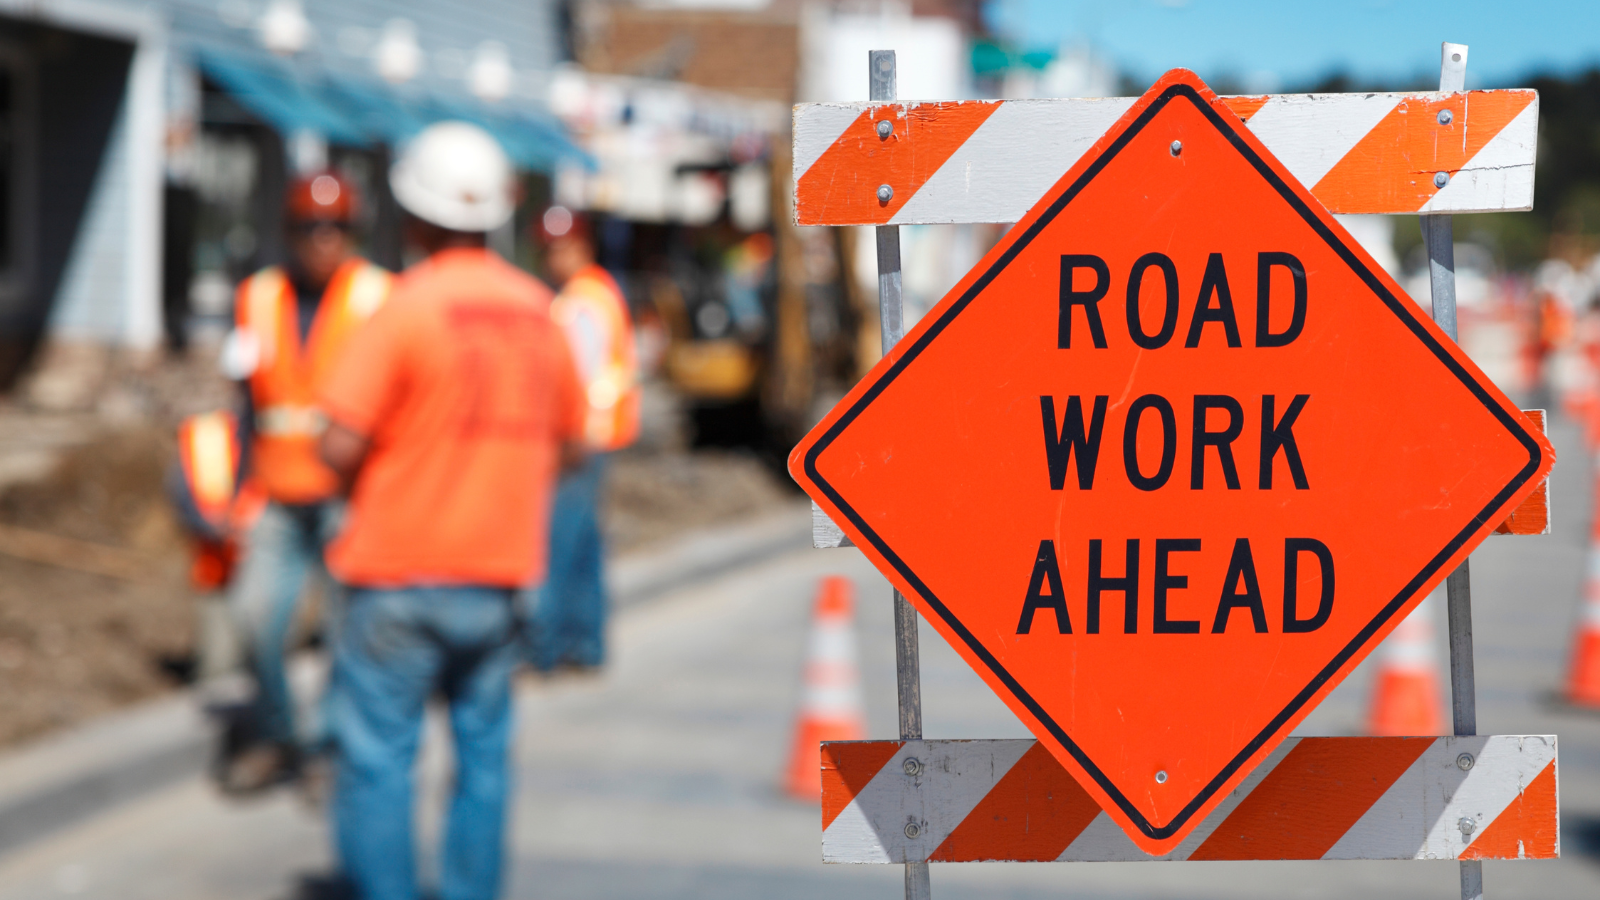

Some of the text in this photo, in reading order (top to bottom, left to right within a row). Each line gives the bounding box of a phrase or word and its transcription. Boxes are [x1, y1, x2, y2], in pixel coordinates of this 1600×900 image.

[1057, 251, 1308, 350] ROAD
[1039, 393, 1310, 491] WORK
[1016, 537, 1336, 635] AHEAD
